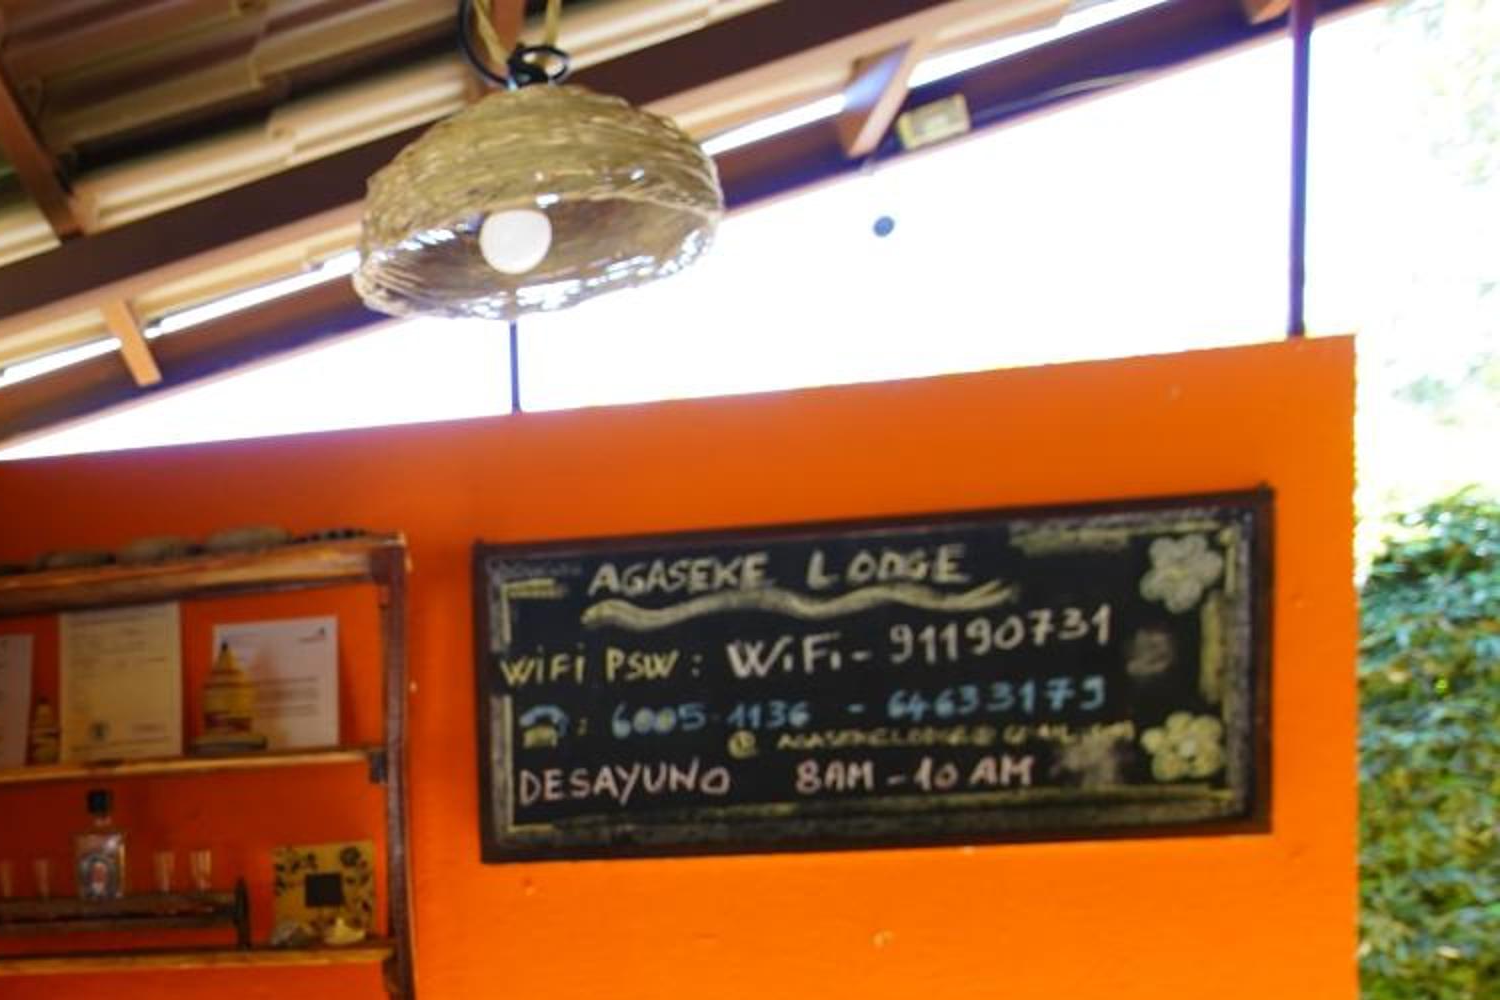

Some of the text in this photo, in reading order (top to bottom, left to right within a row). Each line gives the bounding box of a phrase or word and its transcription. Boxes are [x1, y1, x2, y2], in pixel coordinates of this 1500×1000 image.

[588, 543, 972, 597] AGASEKE LODGE
[519, 756, 731, 806] DESAYUNO
